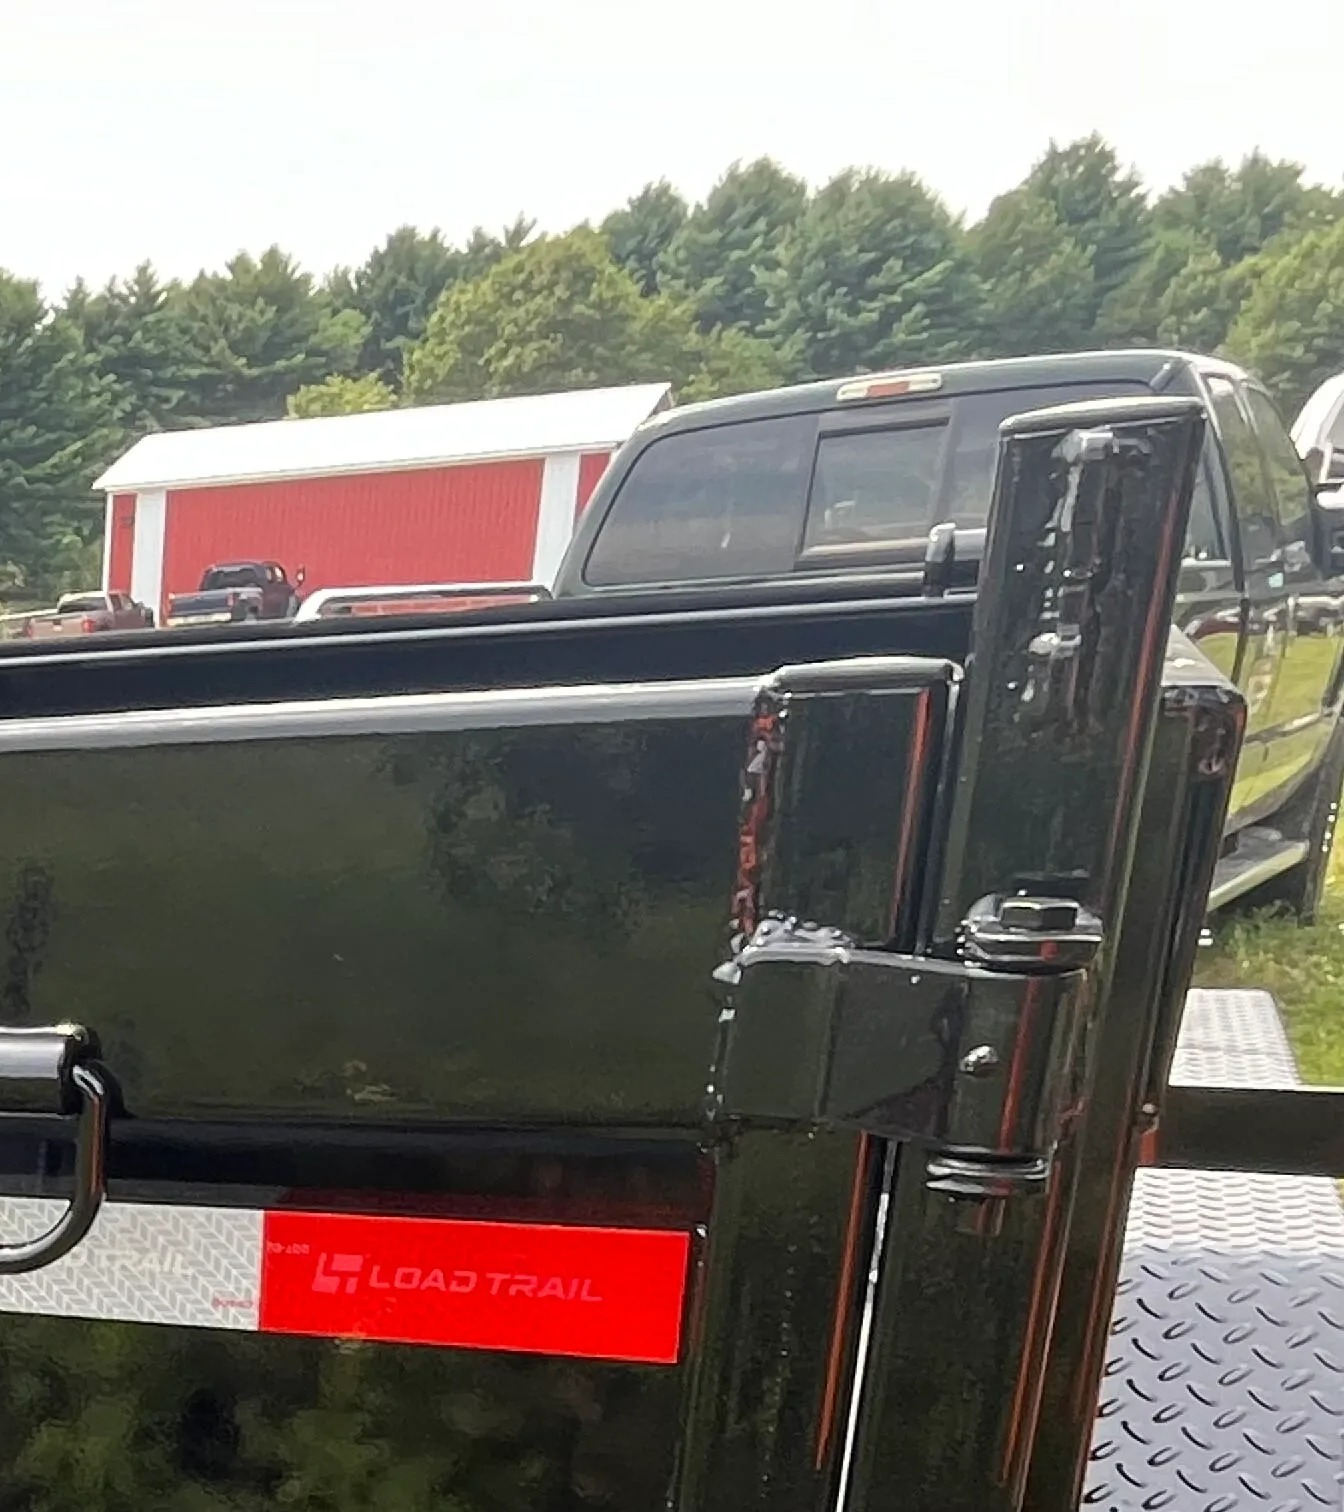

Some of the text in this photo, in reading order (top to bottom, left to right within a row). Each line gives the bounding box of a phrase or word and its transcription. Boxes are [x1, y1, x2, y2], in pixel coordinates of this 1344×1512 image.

[94, 1248, 192, 1276] TRAIL
[368, 1264, 603, 1302] LOAD TRAIL
